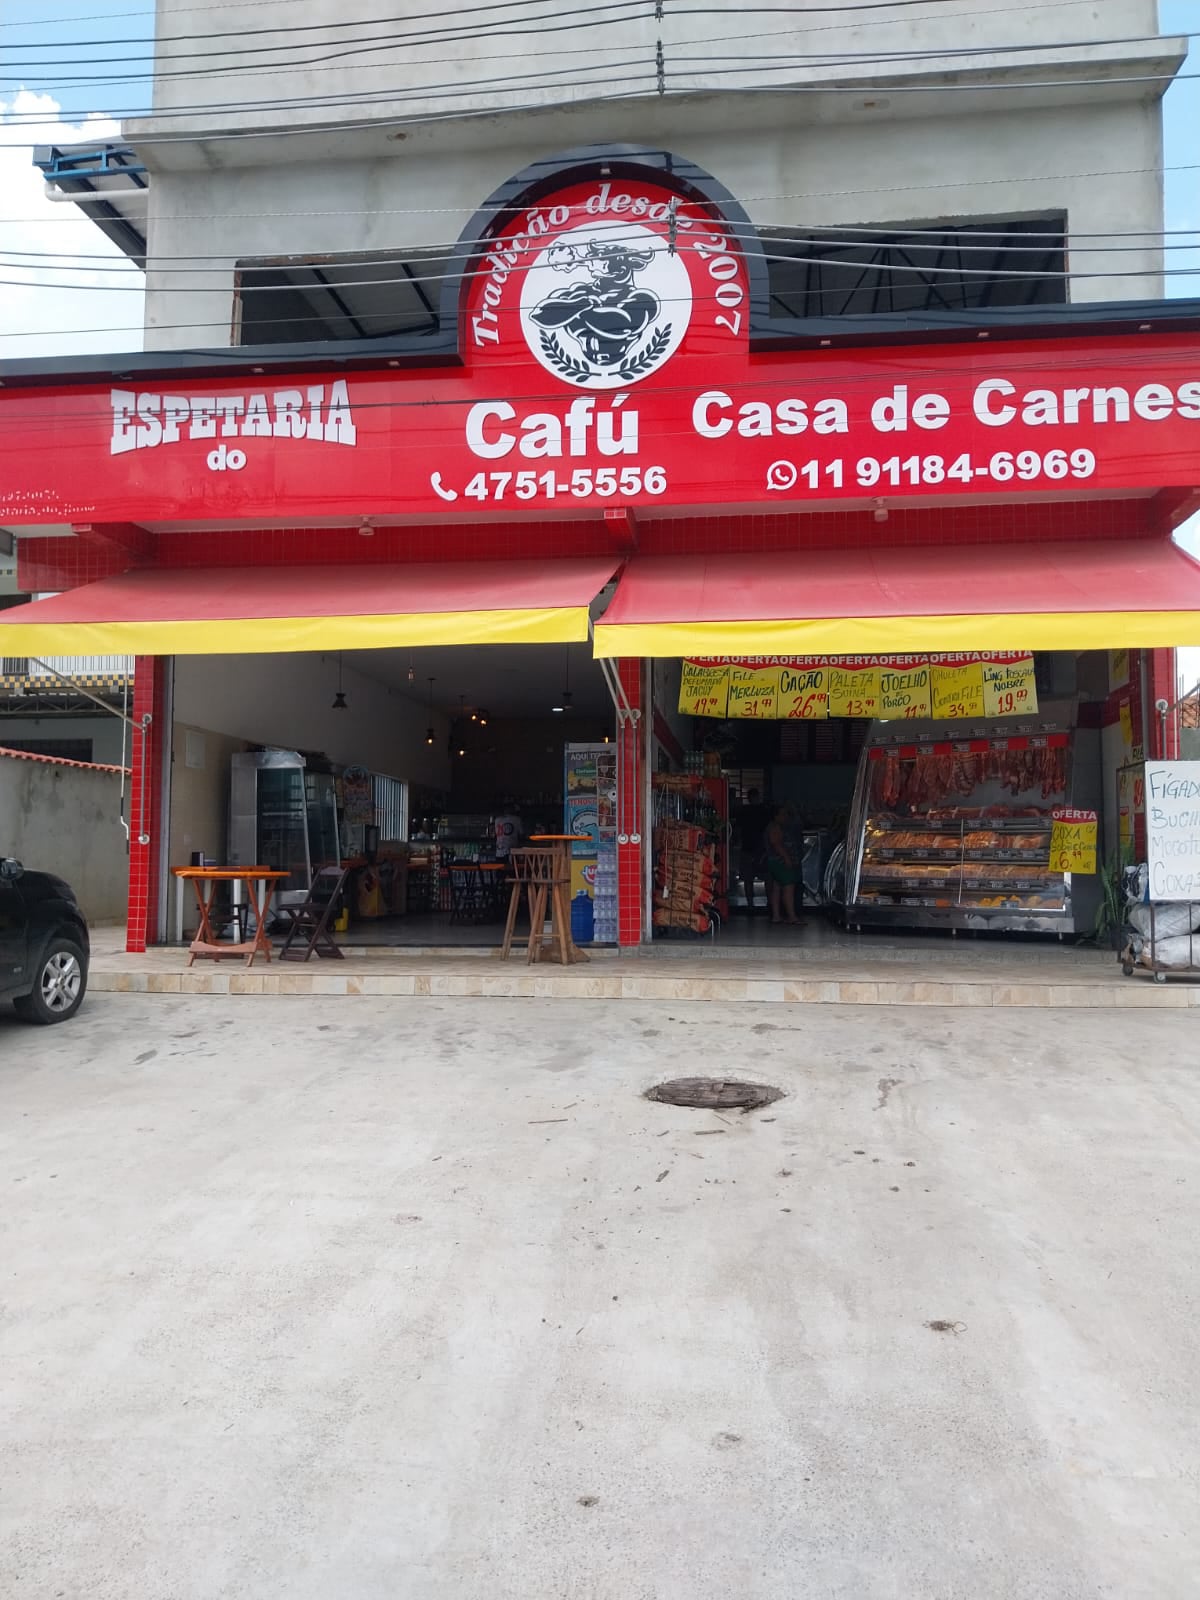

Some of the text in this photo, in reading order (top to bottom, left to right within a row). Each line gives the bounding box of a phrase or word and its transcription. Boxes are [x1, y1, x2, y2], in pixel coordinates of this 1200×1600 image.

[471, 203, 570, 348] Tradição
[693, 234, 743, 336] 2007
[110, 378, 357, 456] ESPETARIA
[692, 378, 1200, 438] Casa de Carnes
[465, 393, 639, 460] Cafú
[206, 444, 248, 472] do
[801, 448, 1096, 489] 11 91184-6969
[464, 466, 667, 501] 4751-5556
[731, 656, 779, 665] OFERTA
[780, 656, 829, 665] OFERTA
[829, 656, 879, 665] OFERTA
[880, 654, 928, 665] OFERTA
[929, 652, 980, 663] OFERTA
[981, 650, 1033, 660] OFERTA
[730, 685, 775, 700] MERLUZA
[781, 670, 823, 693] CAÇÃO
[830, 671, 874, 688] PALETA
[993, 679, 1026, 692] NOBRE
[1052, 809, 1097, 819] OFERTA
